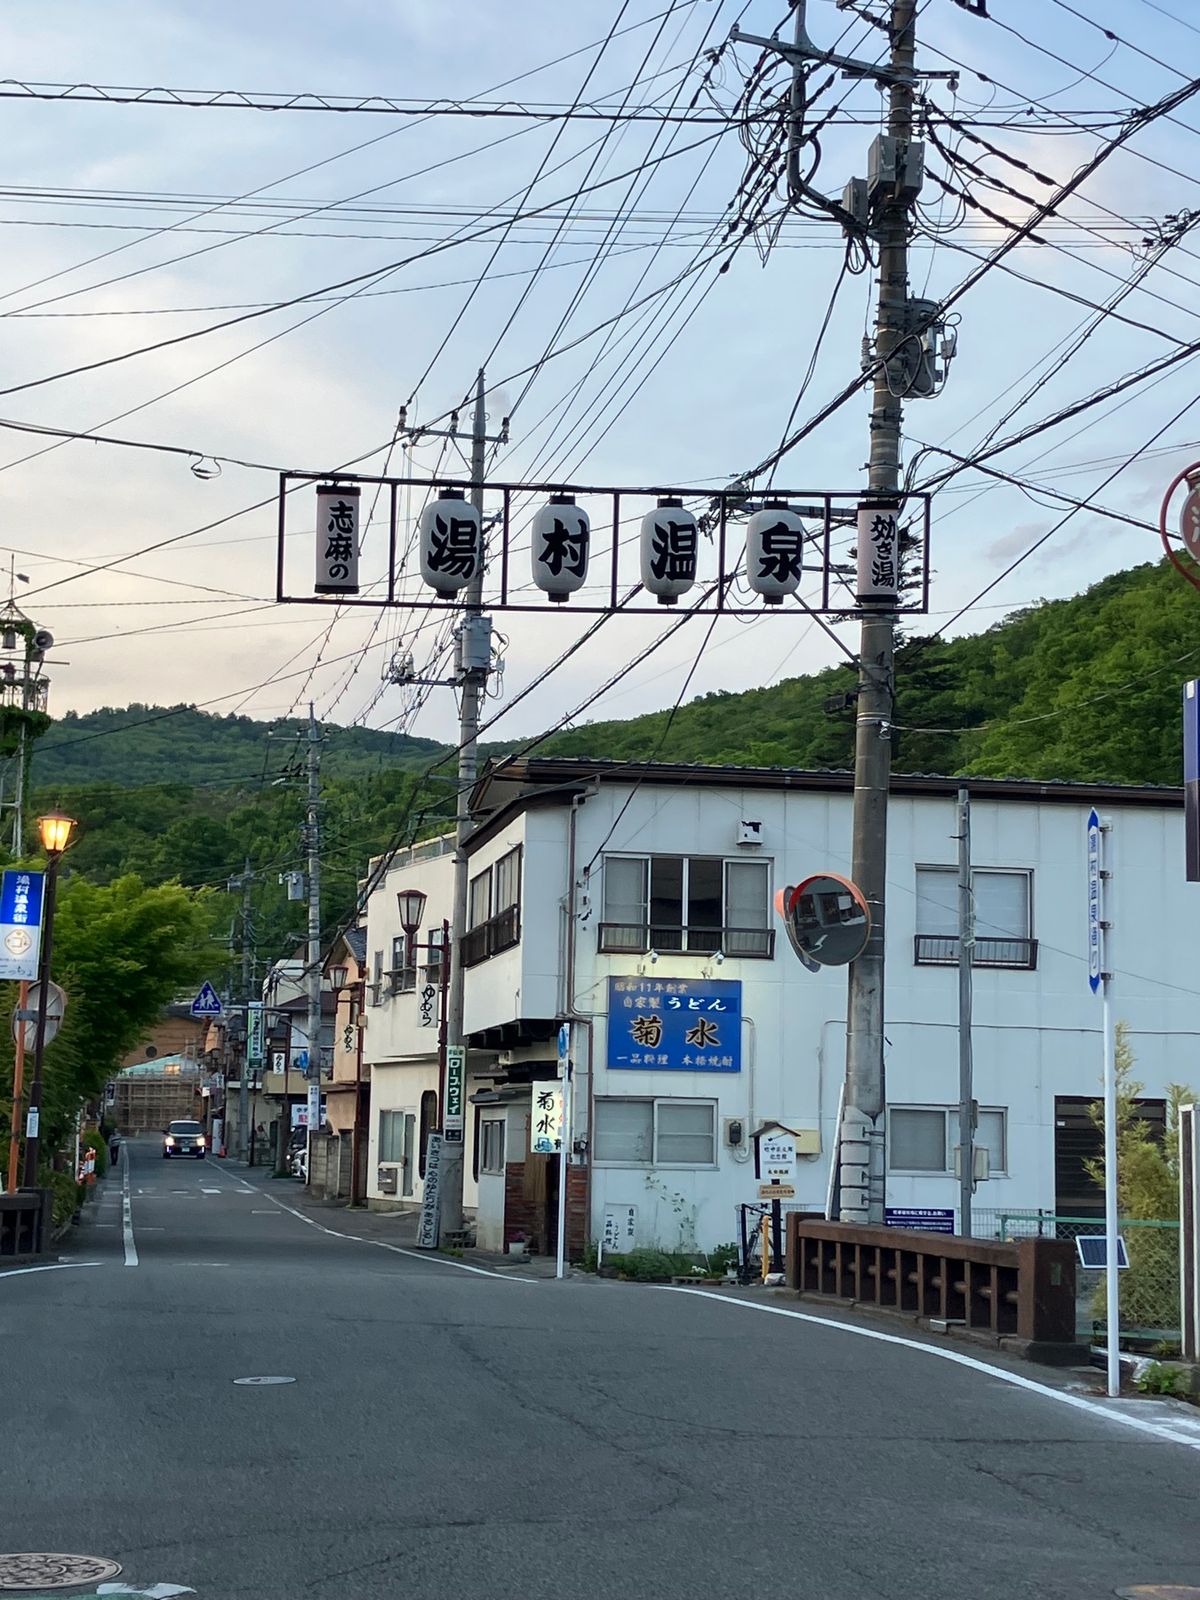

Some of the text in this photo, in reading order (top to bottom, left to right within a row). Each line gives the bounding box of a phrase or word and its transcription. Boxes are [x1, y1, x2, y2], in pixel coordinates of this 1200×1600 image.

[324, 500, 354, 580] 志麻の
[870, 514, 897, 588] 効き湯
[12, 874, 31, 924] 湯村温泉街
[420, 984, 436, 1027] ゆむら
[623, 996, 727, 1011] 自家製 うどん
[628, 1014, 722, 1049] 菊水
[616, 1053, 733, 1067] 一品料理 本格焼酎
[448, 1058, 461, 1114] ロープウェイ
[536, 1090, 555, 1135] 菊水
